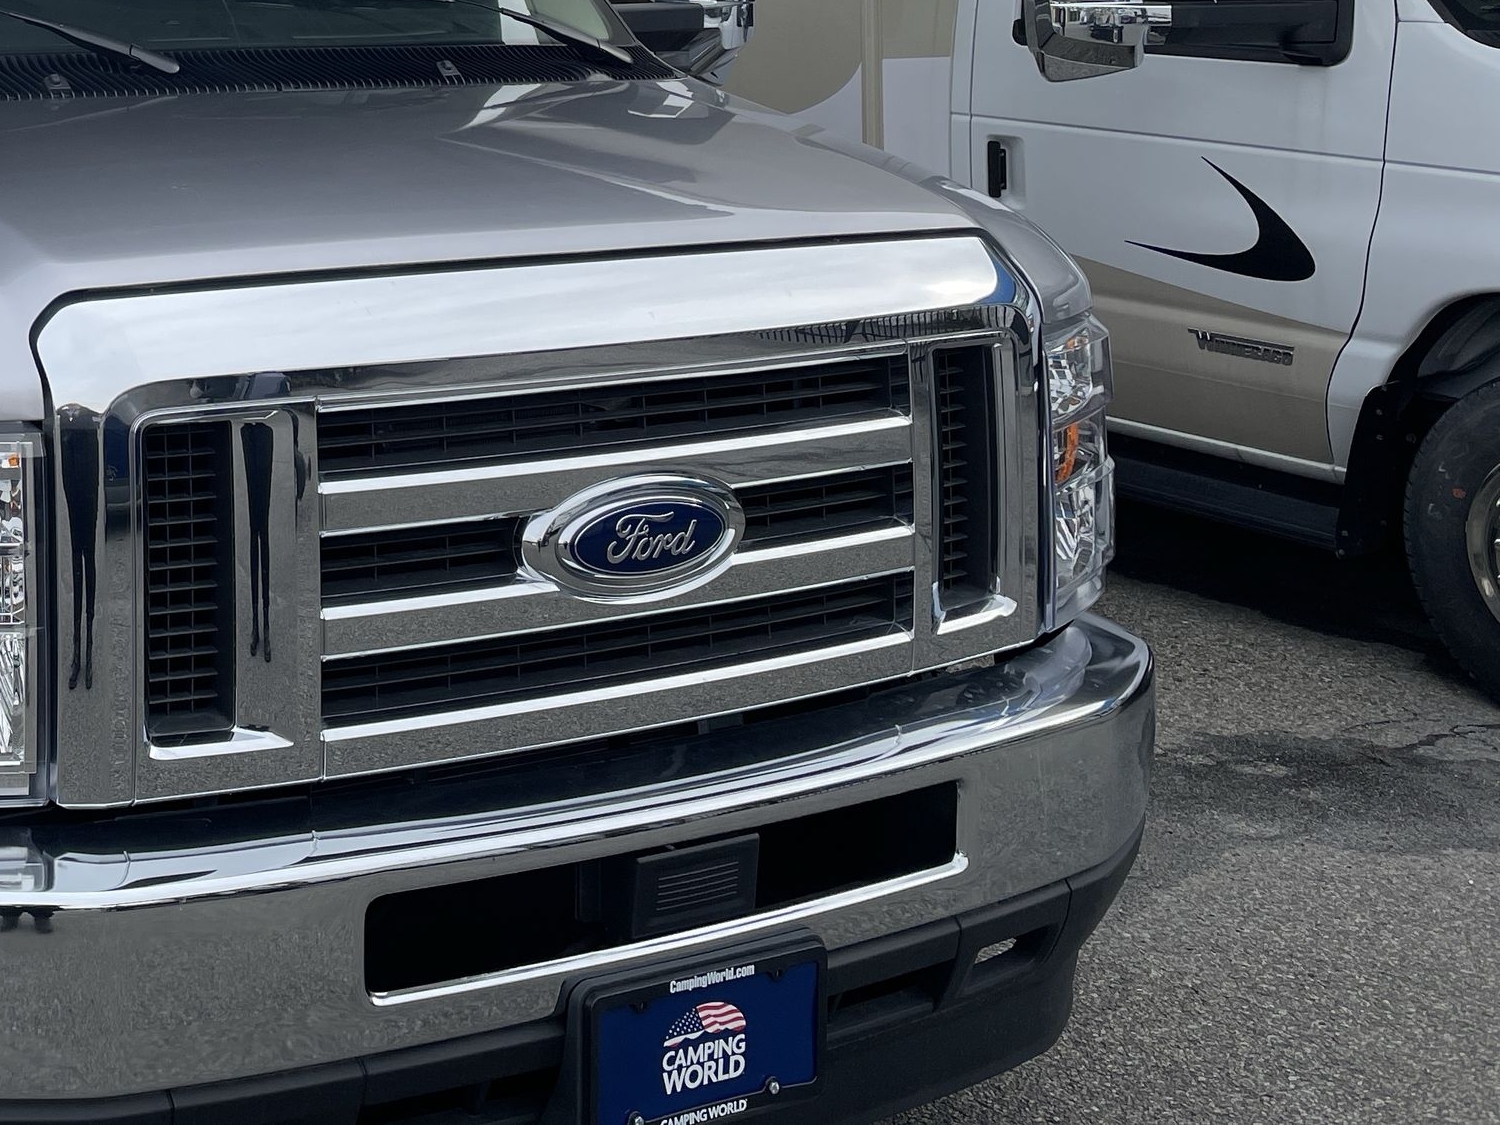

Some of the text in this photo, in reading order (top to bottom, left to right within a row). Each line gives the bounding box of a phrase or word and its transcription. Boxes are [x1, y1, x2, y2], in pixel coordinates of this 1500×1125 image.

[607, 511, 697, 564] Ford
[669, 964, 755, 994] CampingWorld.com
[662, 1034, 746, 1071] CAMPING
[662, 1055, 745, 1095] WORLD
[708, 1100, 747, 1119] WORLD
